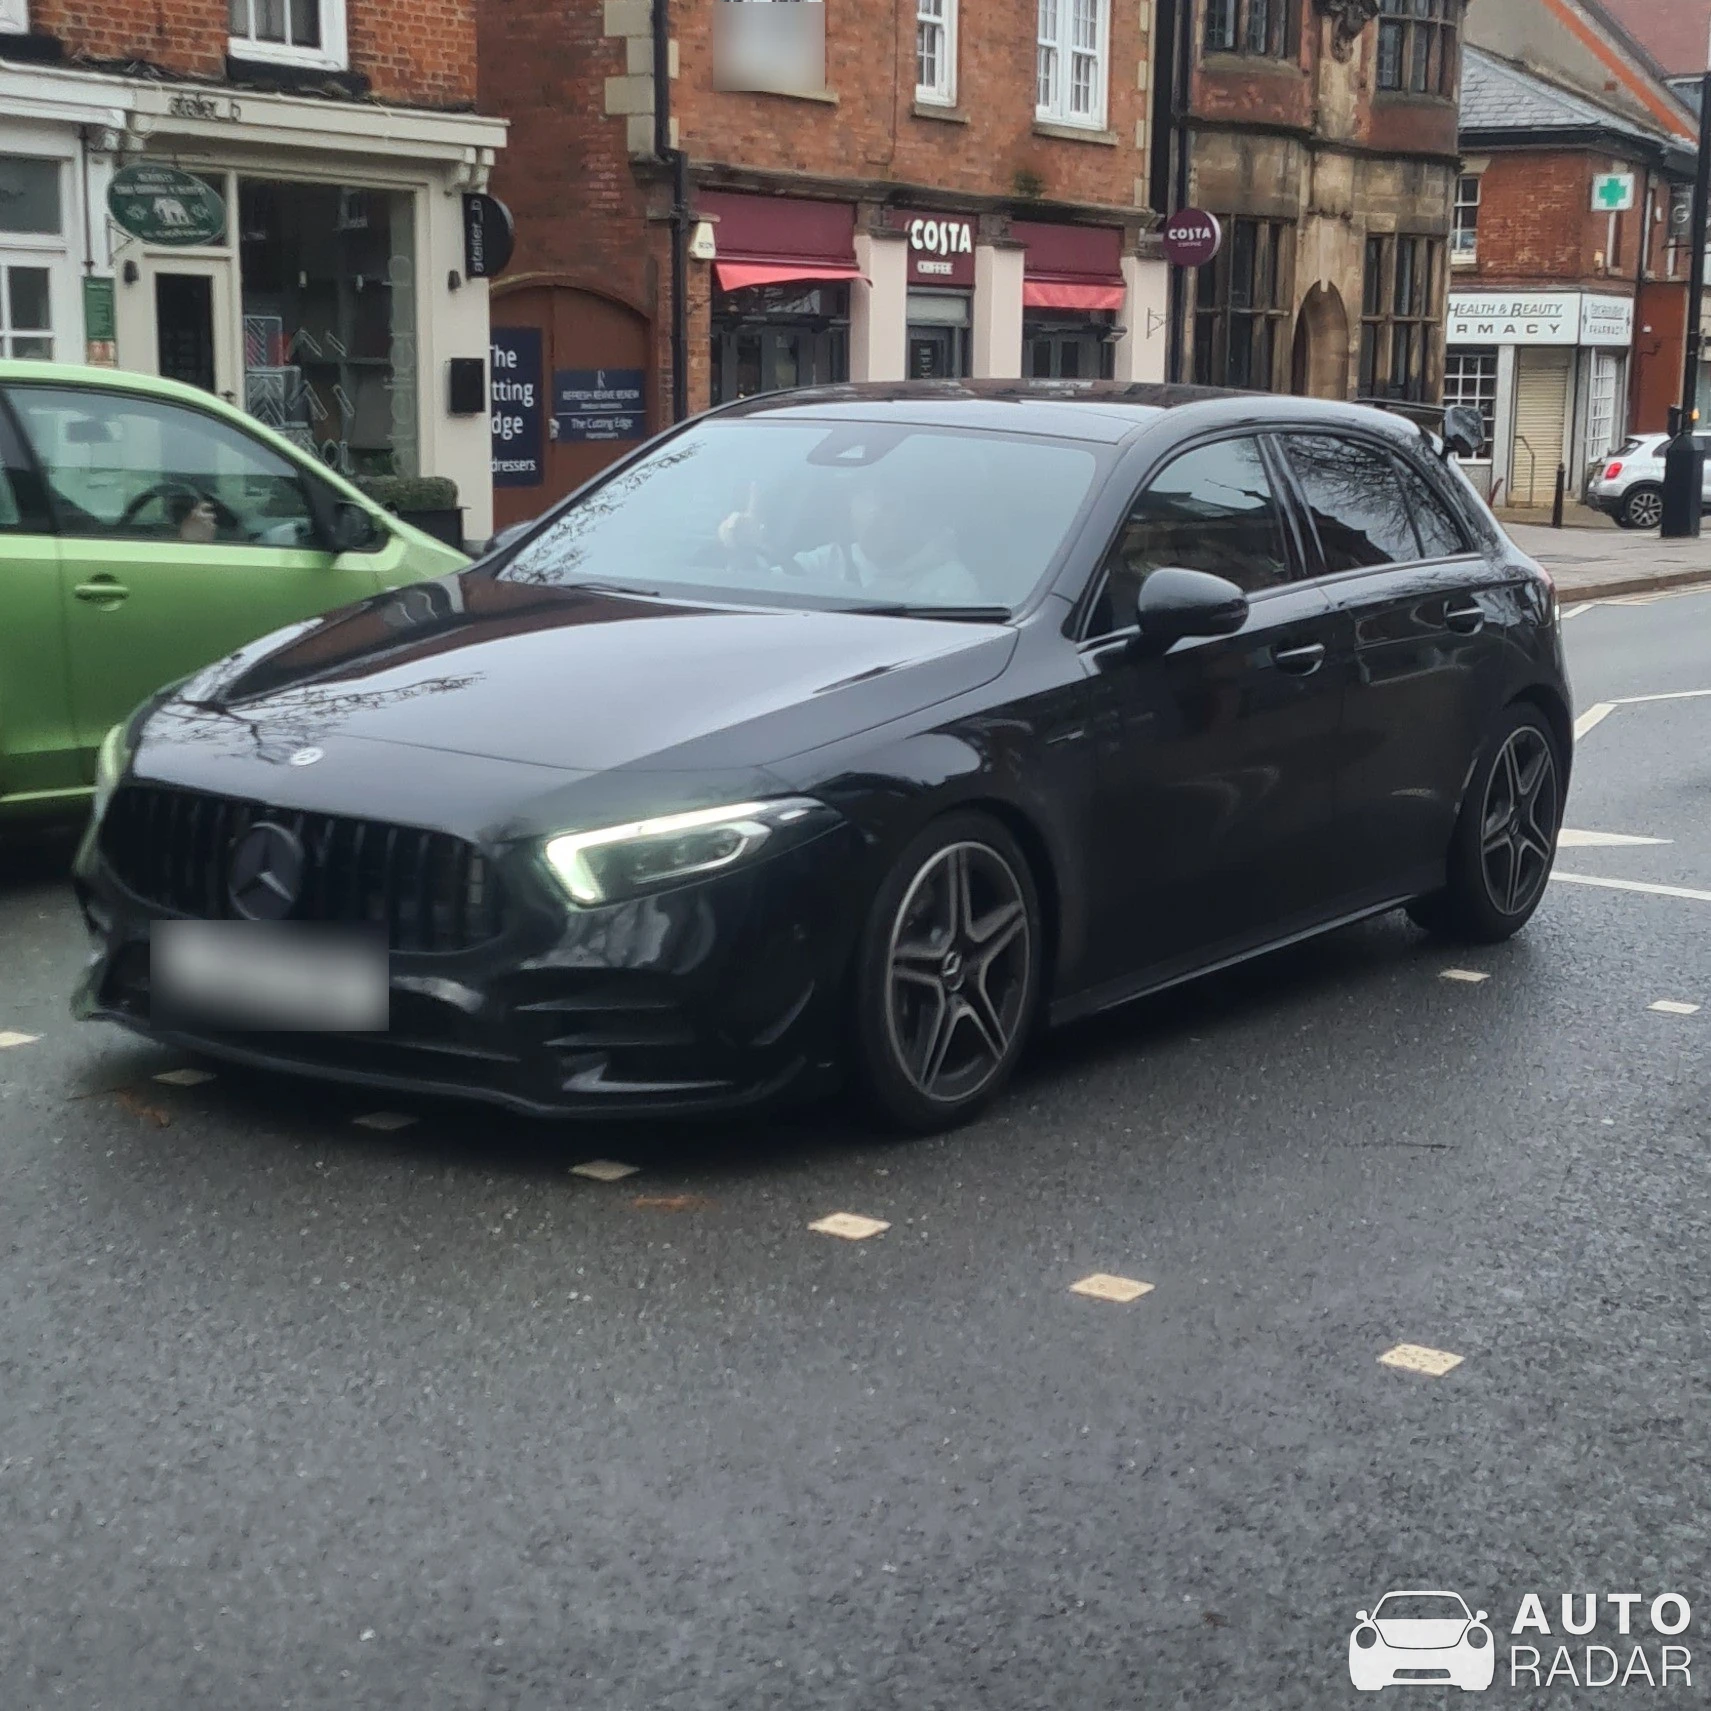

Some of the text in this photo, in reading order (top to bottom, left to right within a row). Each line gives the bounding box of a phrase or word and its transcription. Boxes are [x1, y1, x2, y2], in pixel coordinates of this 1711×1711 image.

[911, 218, 972, 256] COSTA
[1168, 227, 1211, 241] COSTA
[917, 260, 953, 275] COFFEE
[1510, 303, 1563, 318] BEAUTY
[571, 417, 586, 430] The
